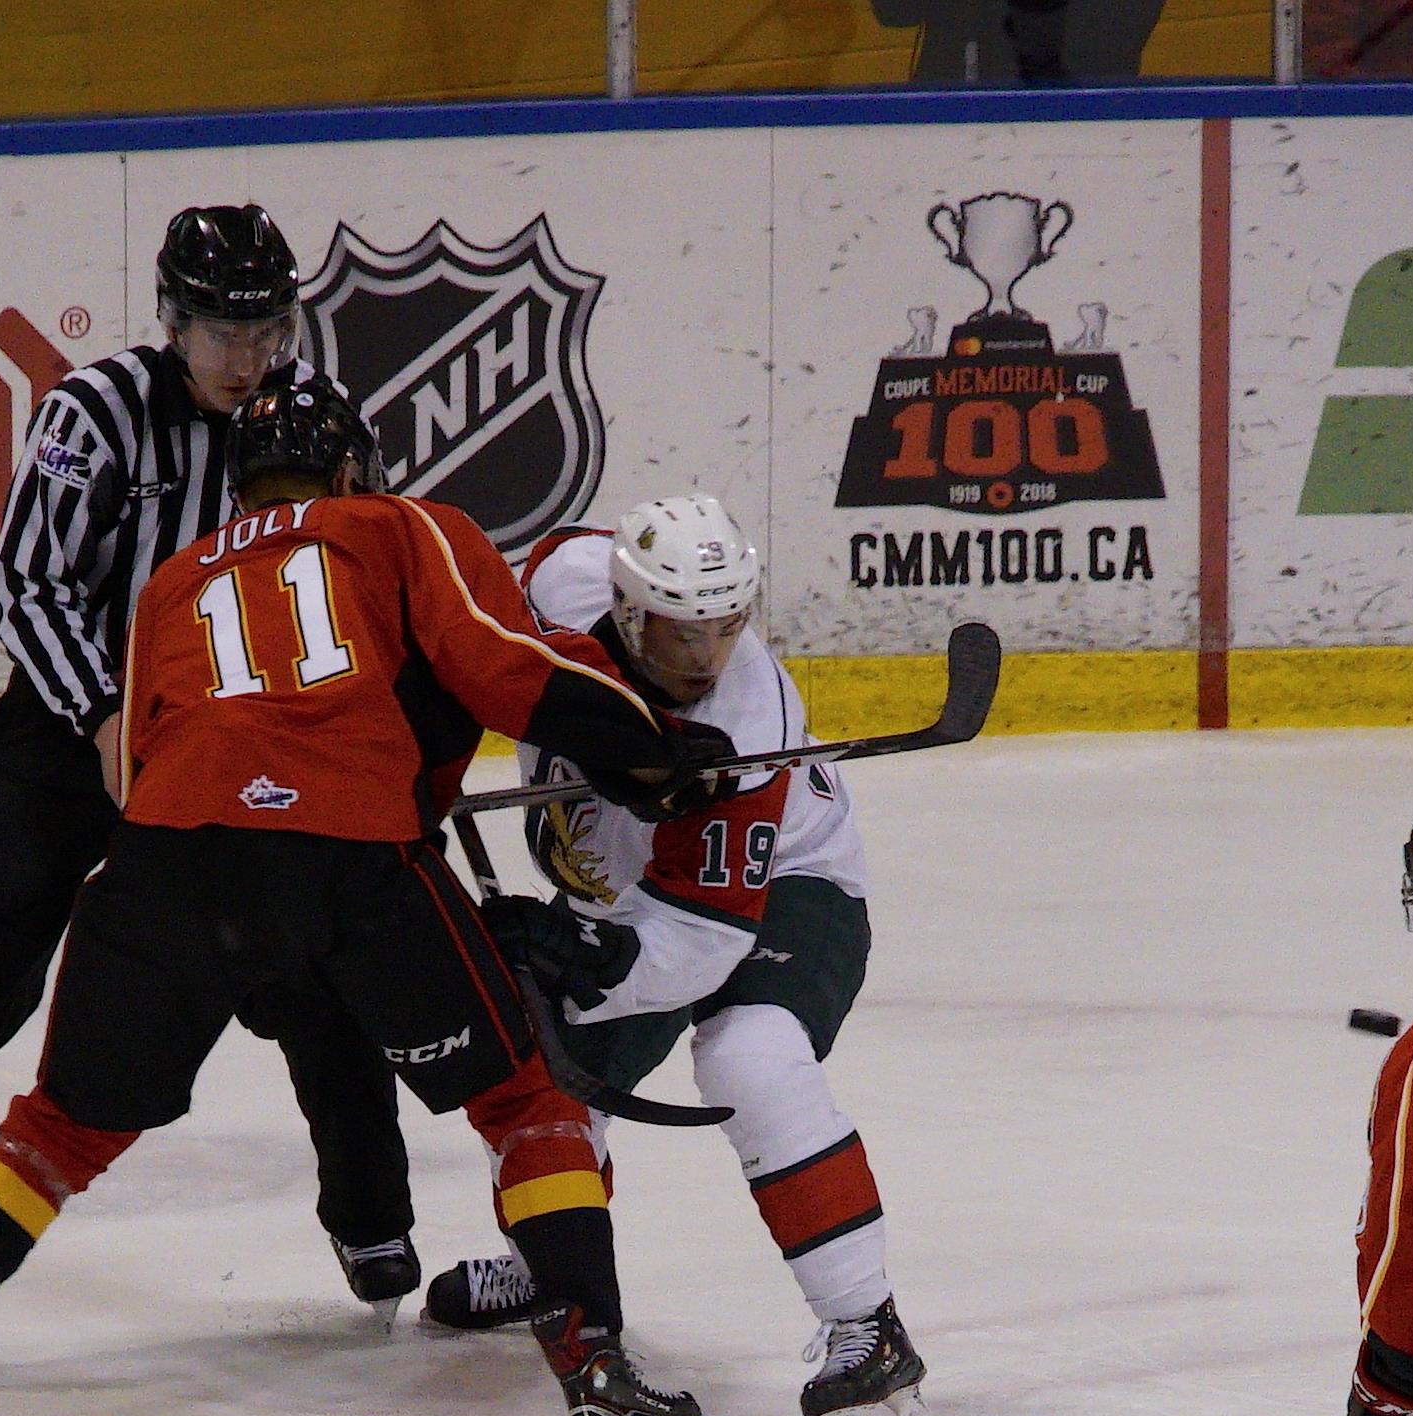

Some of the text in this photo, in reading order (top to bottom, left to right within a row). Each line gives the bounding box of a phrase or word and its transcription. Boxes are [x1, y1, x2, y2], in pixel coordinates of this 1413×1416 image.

[884, 367, 1109, 398] COUPE MEMORIAL CUP
[883, 400, 1110, 479] 100
[198, 500, 317, 567] JOLY
[850, 527, 1154, 588] CMM100.CA
[196, 542, 359, 698] 11
[699, 820, 781, 889] 19
[382, 1024, 471, 1065] CCM
